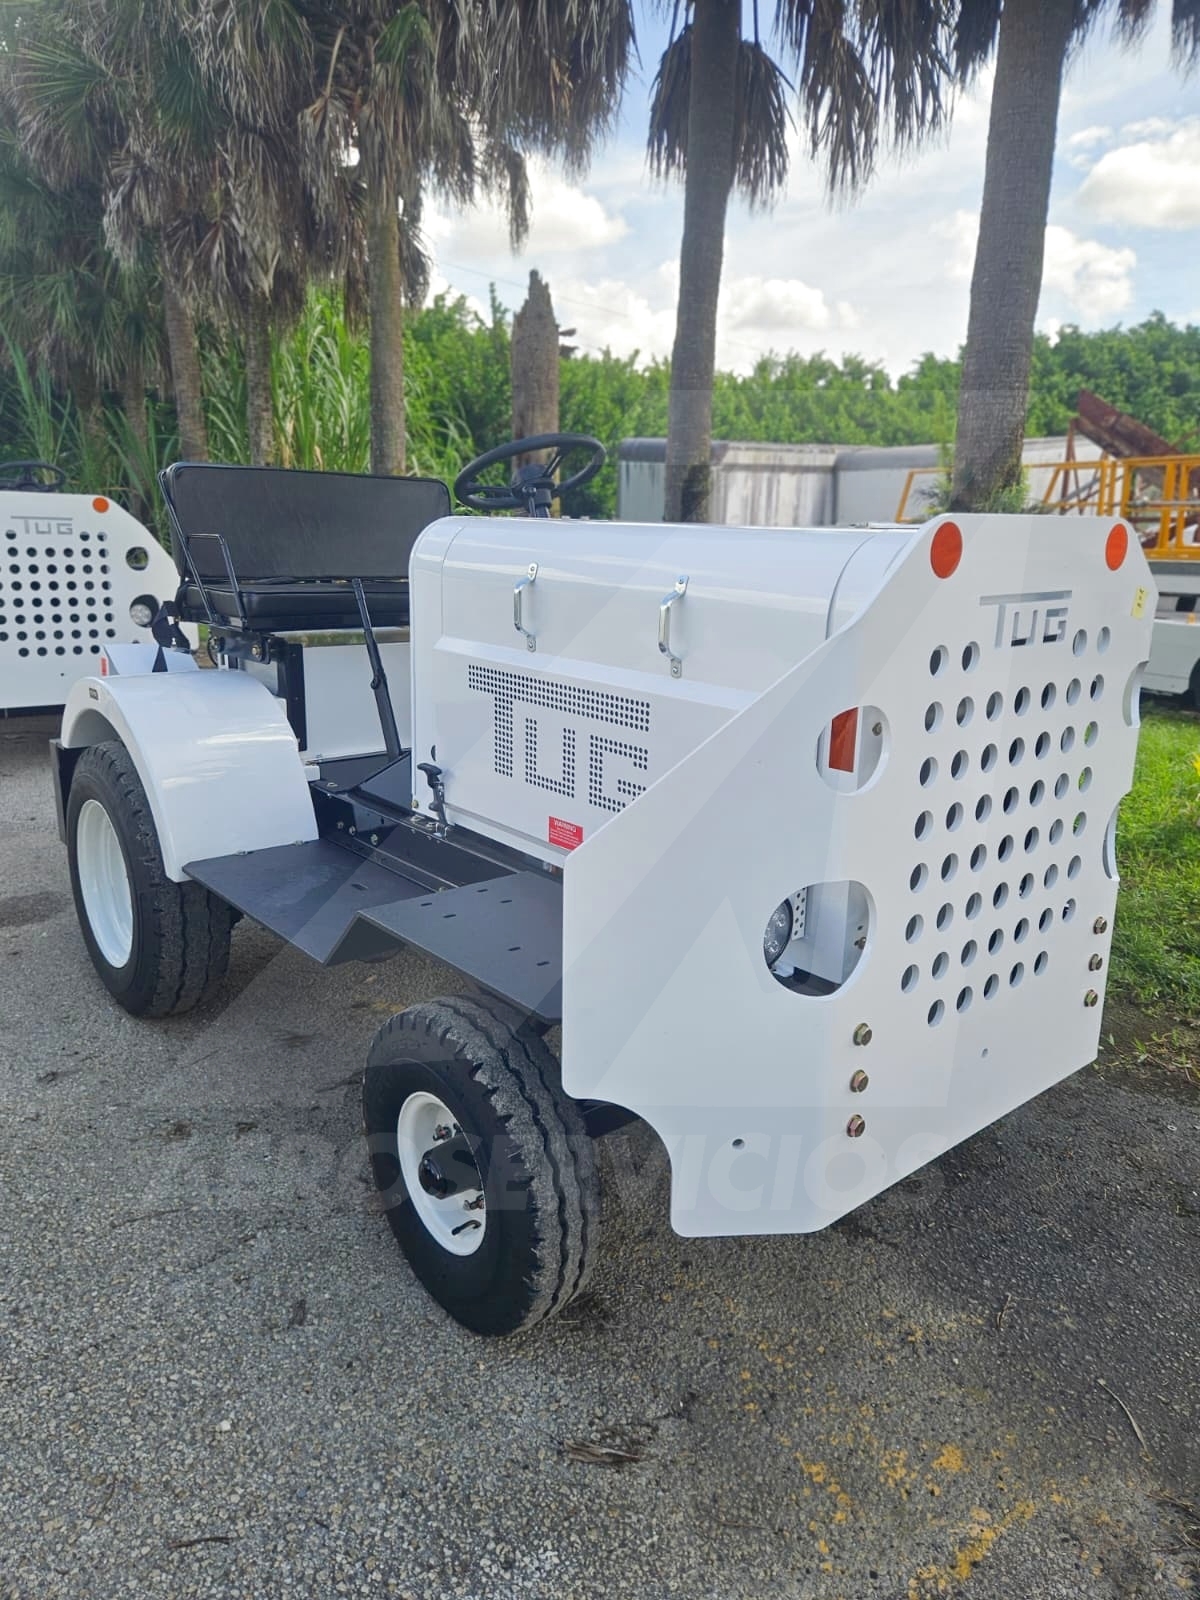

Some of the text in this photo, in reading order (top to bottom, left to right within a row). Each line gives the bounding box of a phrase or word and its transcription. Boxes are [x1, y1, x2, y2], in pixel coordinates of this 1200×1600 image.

[10, 515, 74, 536] TUG
[979, 589, 1073, 649] TUG
[468, 664, 651, 814] TUG
